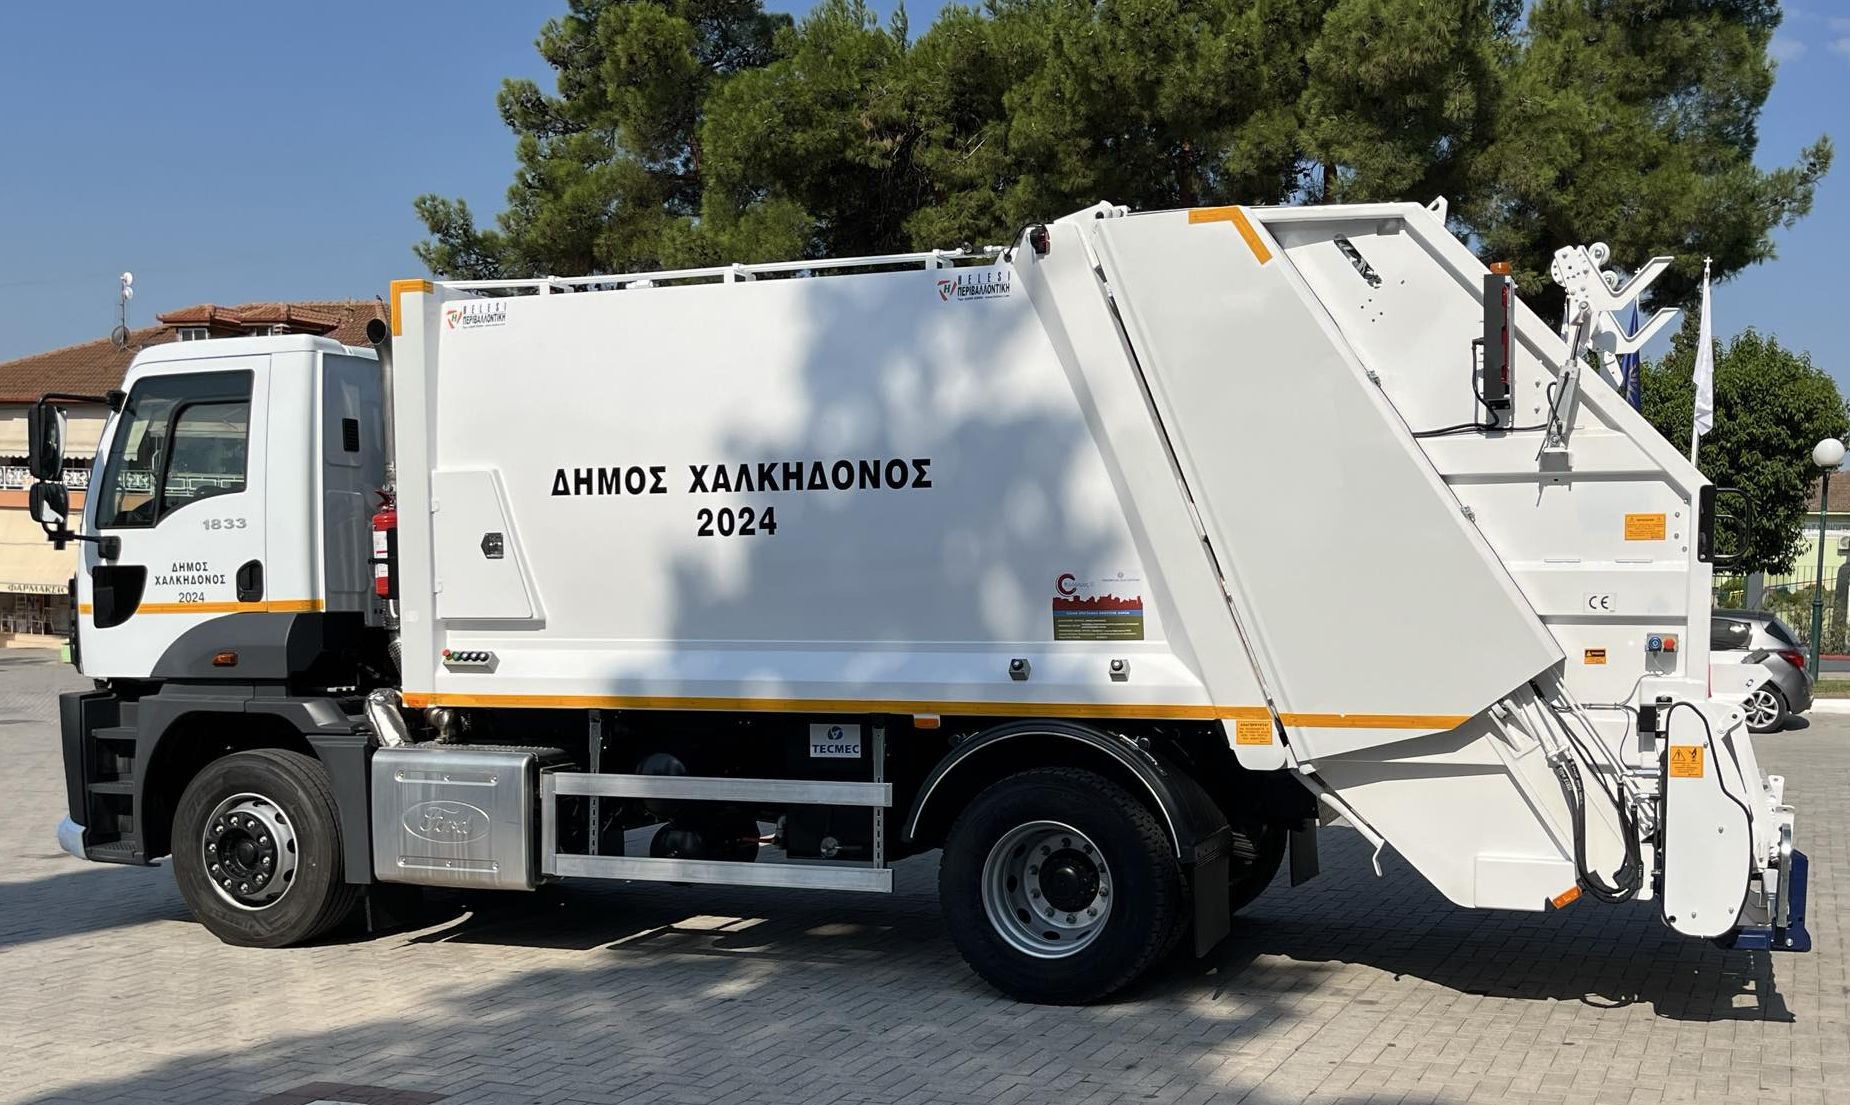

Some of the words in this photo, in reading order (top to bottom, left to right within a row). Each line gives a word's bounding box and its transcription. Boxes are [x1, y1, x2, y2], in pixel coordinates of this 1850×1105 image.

[957, 282, 1010, 297] ΠΕΡΙΒΑΛΛΟΝΤΙΚΗ
[551, 466, 668, 496] ΔΗΜΟΣ
[688, 458, 932, 493] ΧΑΛΚΗΔΟΝΟΣ
[202, 518, 247, 530] 1833
[696, 506, 777, 537] 2024
[171, 561, 208, 573] ΔΗΜΟΣ
[154, 574, 226, 586] ΧΑΛΚΗΔΟΝΟΣ
[178, 591, 205, 603] 2024
[1588, 595, 1609, 610] CE
[811, 744, 860, 754] TECMEC
[420, 806, 475, 834] Ford
